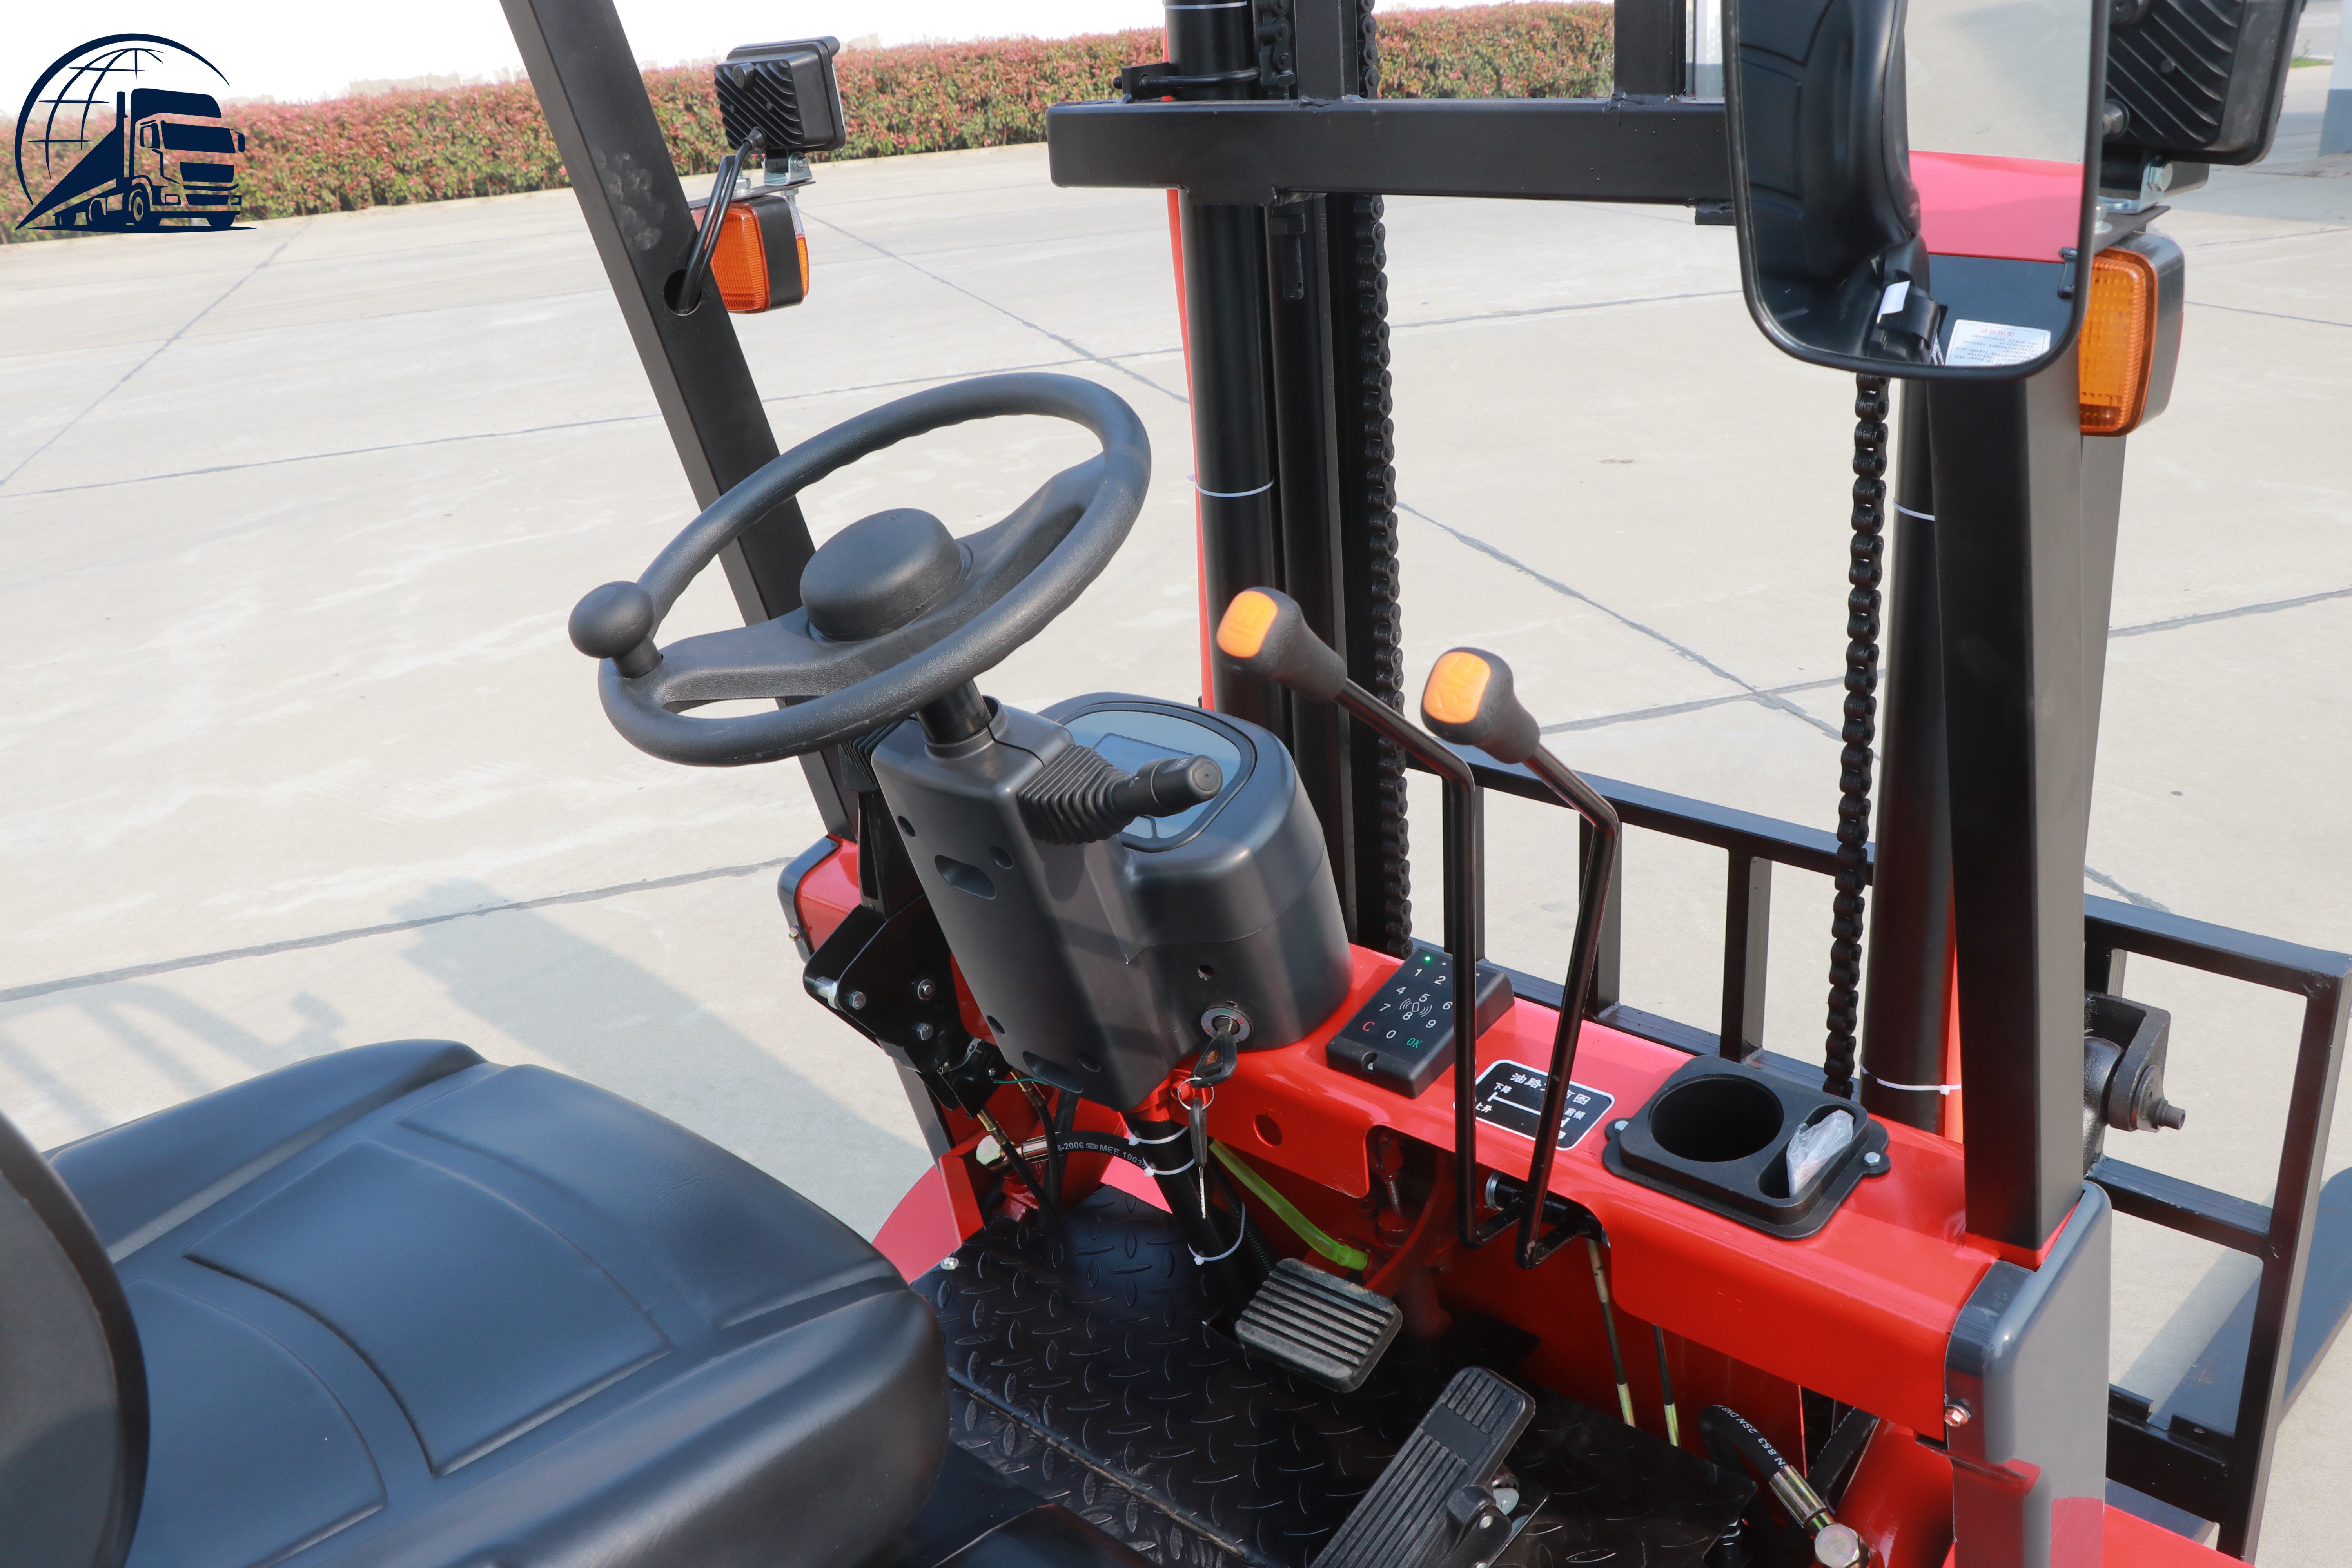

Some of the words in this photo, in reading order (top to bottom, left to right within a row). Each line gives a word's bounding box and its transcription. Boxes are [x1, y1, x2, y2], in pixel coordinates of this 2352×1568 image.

[1414, 968, 1423, 977] 1
[1434, 976, 1446, 985] 2
[1396, 986, 1406, 995] 4
[1419, 993, 1430, 1002] 5
[1443, 1001, 1453, 1010] 6
[1379, 1003, 1391, 1012] 7
[1402, 1011, 1413, 1021] 8
[1426, 1019, 1436, 1029] 9
[1363, 1021, 1375, 1032] C
[1386, 1030, 1396, 1039] 0
[1407, 1037, 1423, 1049] OK
[1494, 1082, 1513, 1094] 下降
[1510, 1073, 1592, 1105] 油路图
[1564, 1107, 1586, 1120] 前倾
[1100, 1144, 1120, 1156] MEE
[1736, 1418, 1759, 1434] 2SN
[1758, 1437, 1777, 1455] 853
